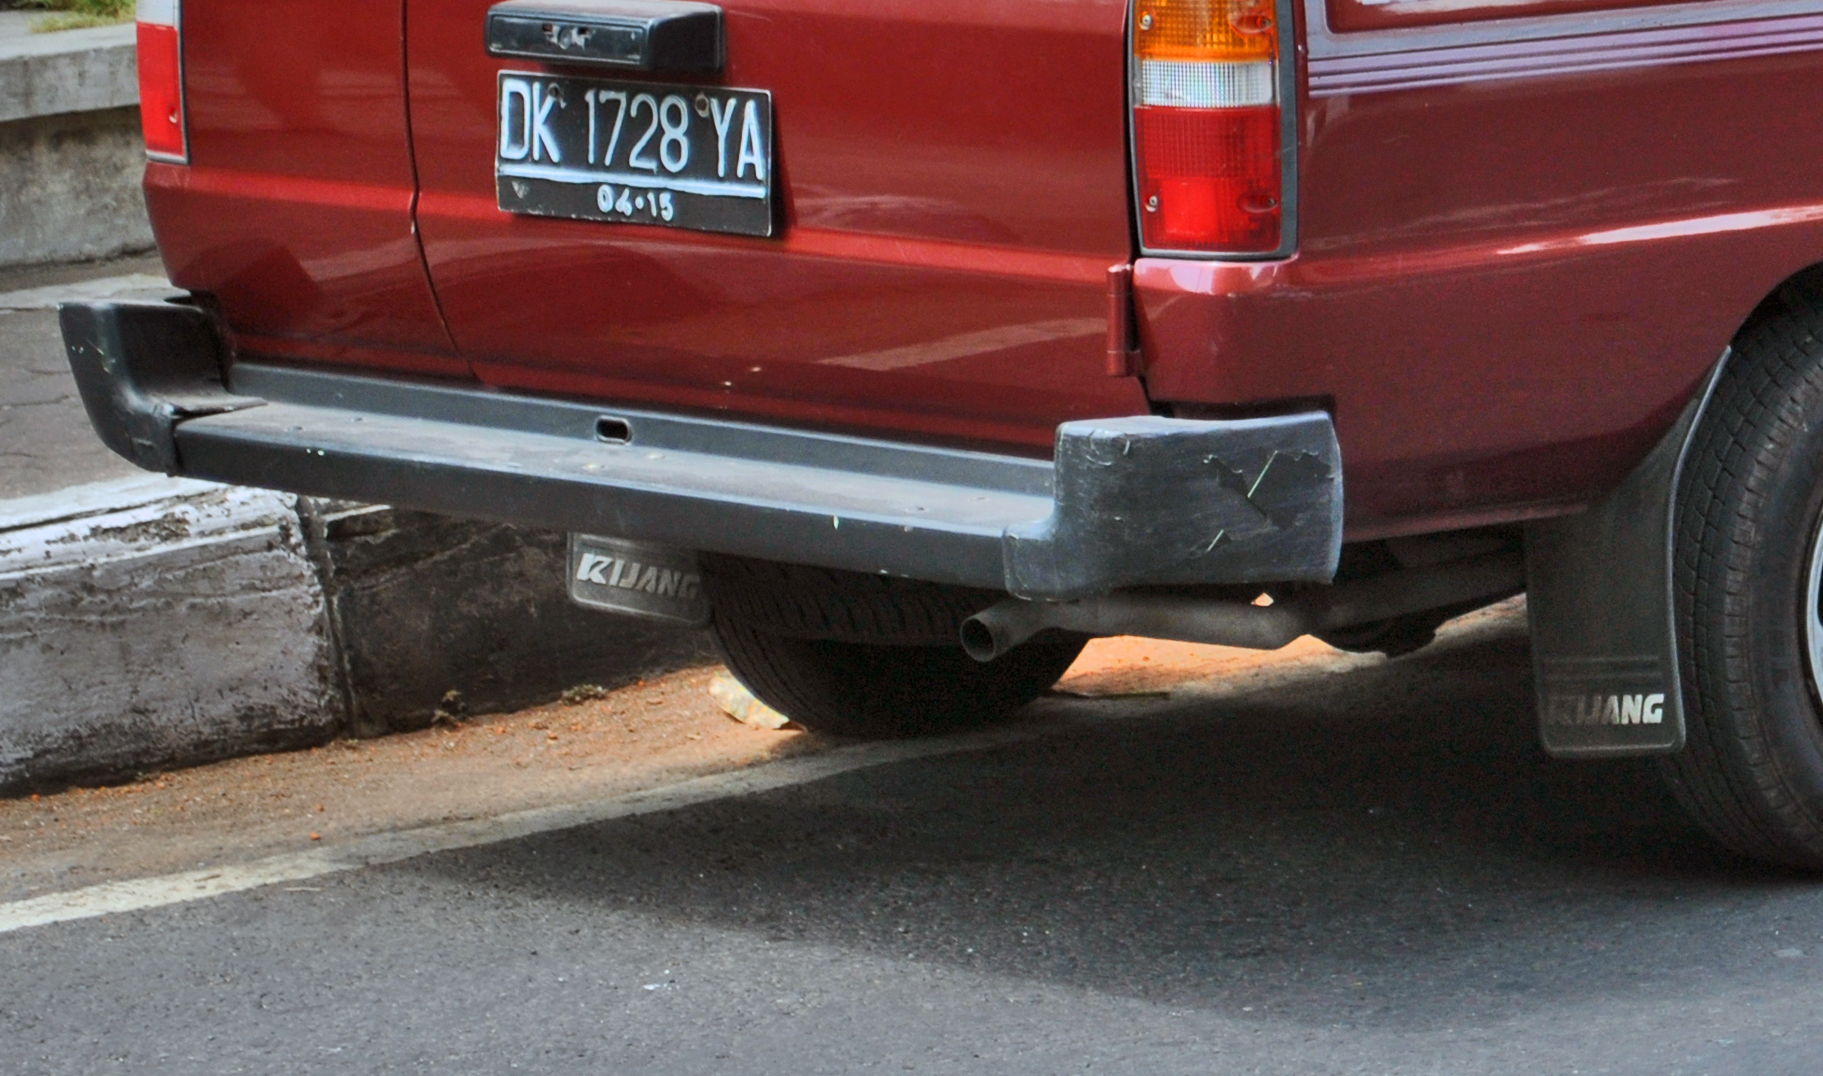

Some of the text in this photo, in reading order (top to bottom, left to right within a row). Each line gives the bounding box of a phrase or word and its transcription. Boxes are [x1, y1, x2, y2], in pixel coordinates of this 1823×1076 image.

[500, 79, 765, 180] DK 1728 YA
[576, 552, 700, 600] KIJANG
